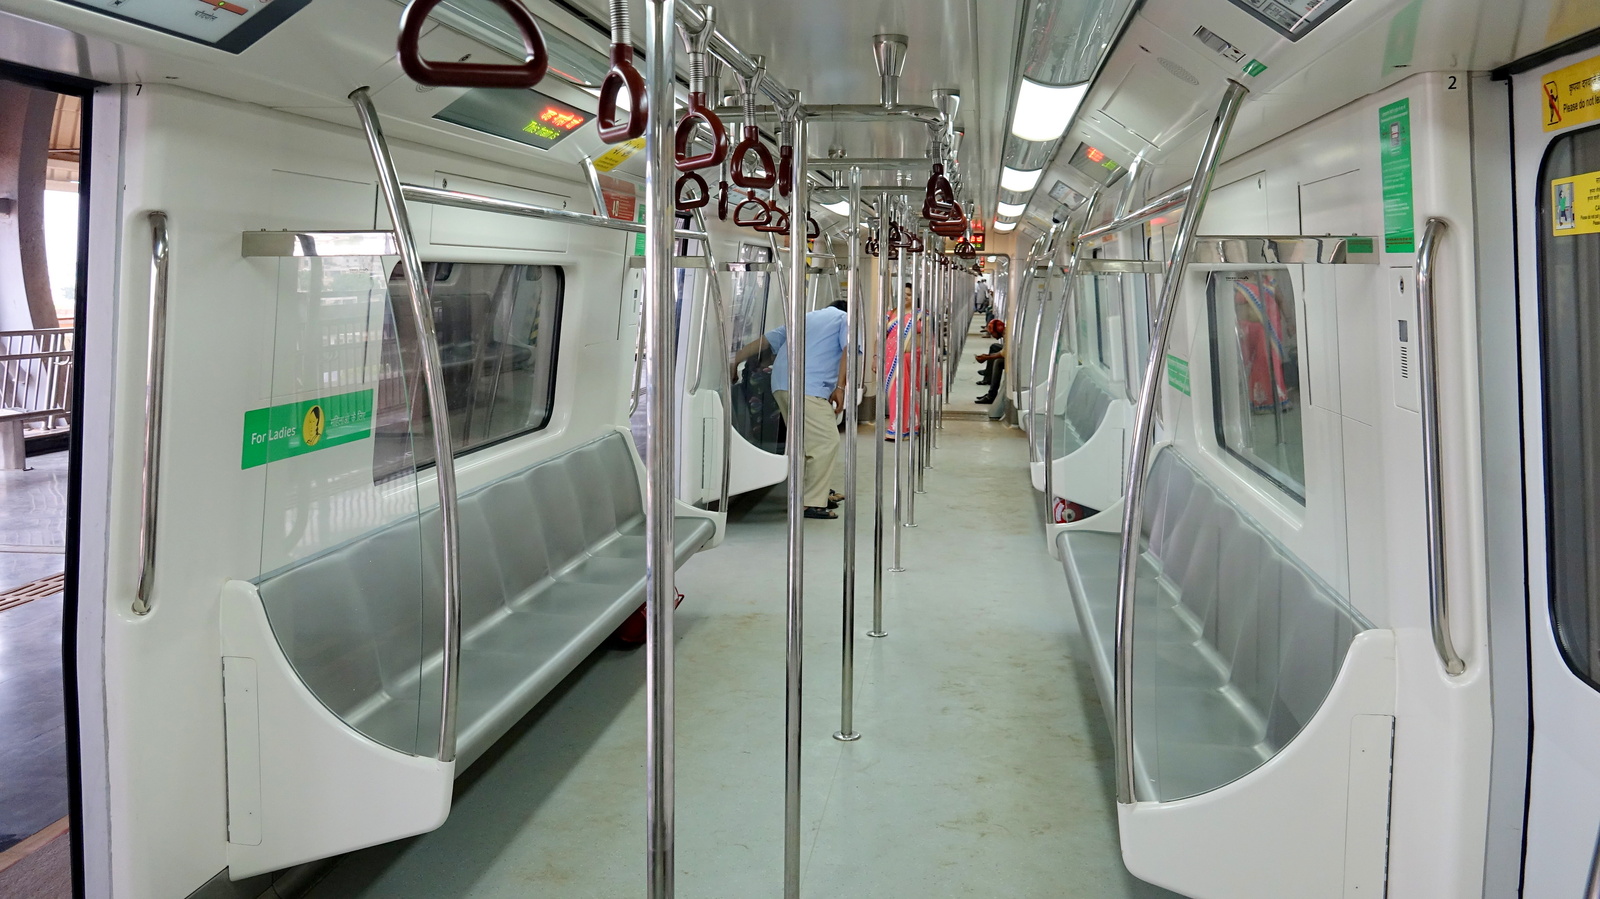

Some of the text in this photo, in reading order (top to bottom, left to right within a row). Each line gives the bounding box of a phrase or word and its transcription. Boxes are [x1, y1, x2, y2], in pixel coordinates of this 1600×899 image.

[1448, 75, 1457, 89] 2
[135, 84, 142, 96] 7
[1563, 102, 1578, 113] Please
[1579, 99, 1585, 109] do
[1586, 96, 1594, 107] not
[251, 427, 296, 445] For Ladies
